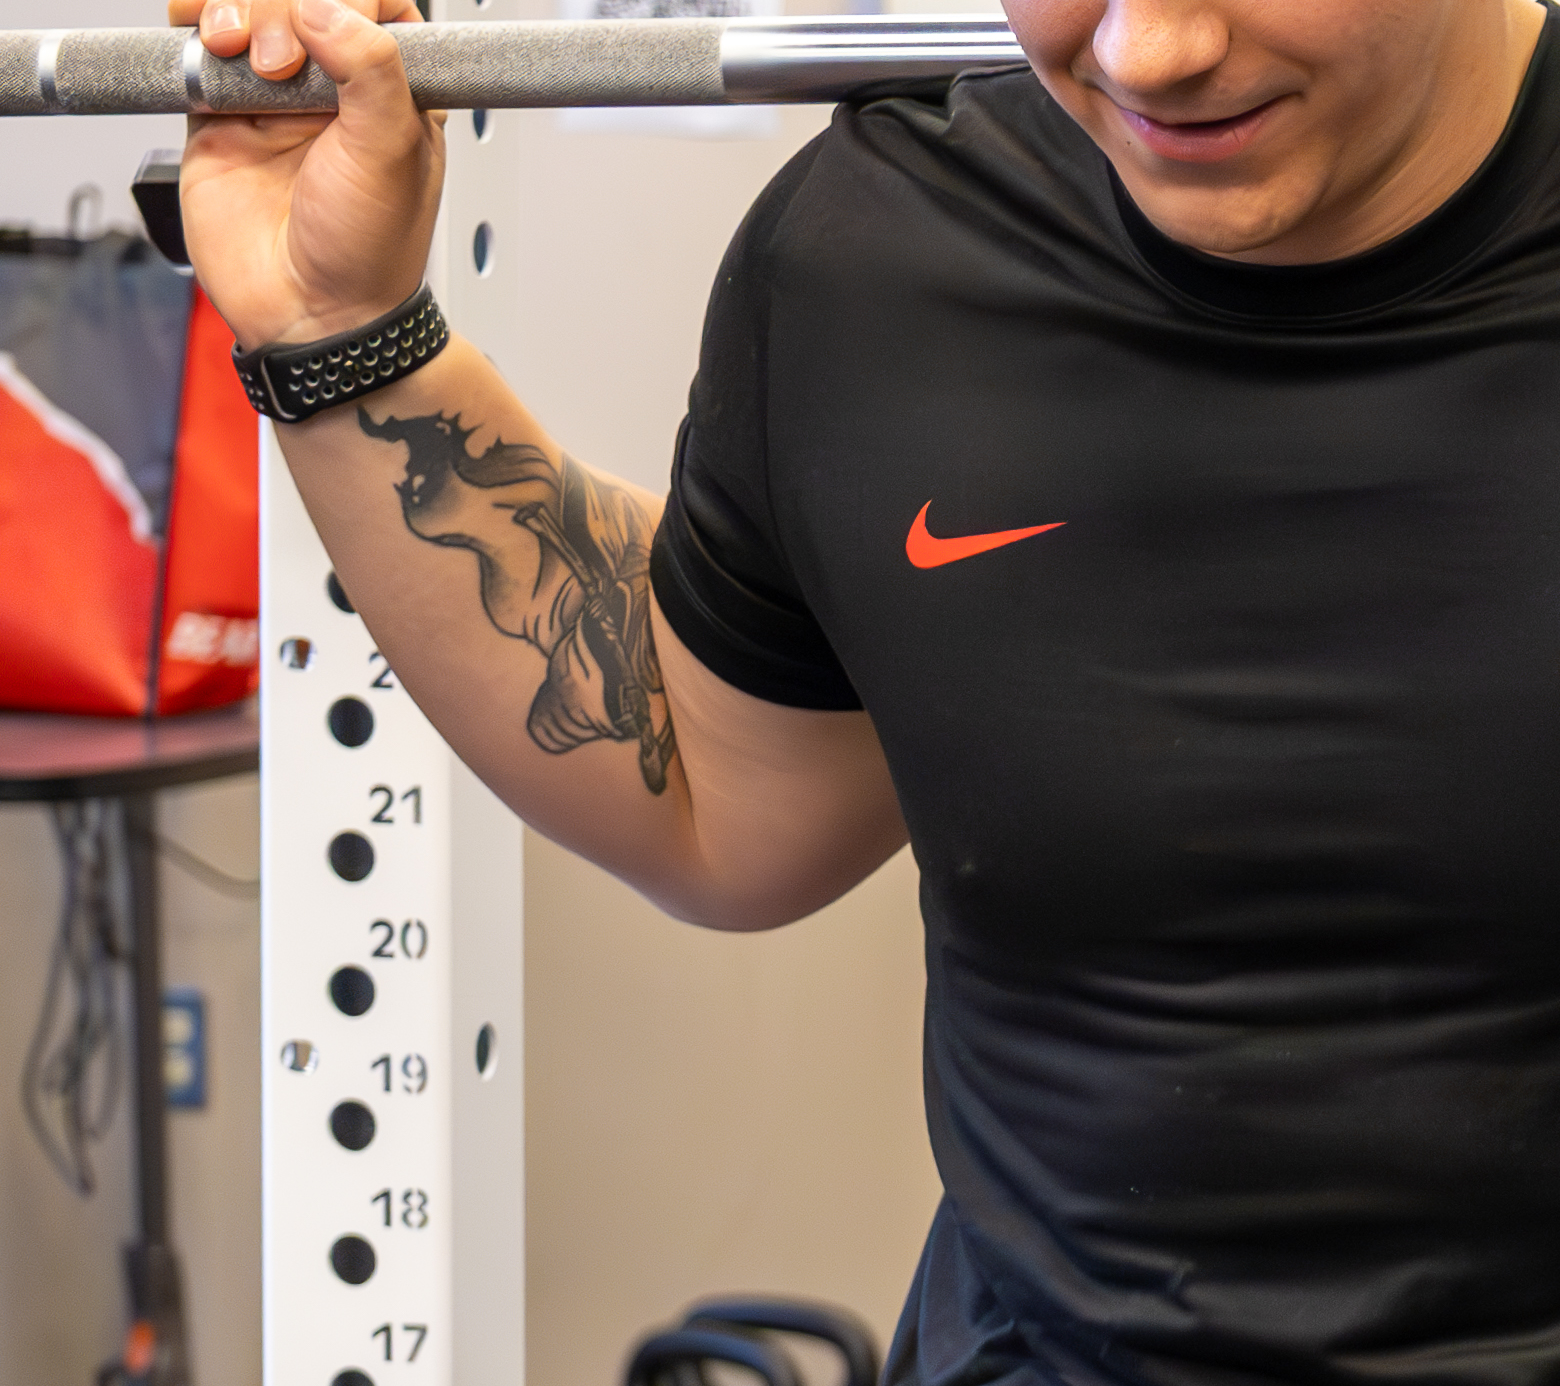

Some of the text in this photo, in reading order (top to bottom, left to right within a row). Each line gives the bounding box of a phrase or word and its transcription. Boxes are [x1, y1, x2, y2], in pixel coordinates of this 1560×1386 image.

[369, 651, 394, 689] 2
[368, 782, 423, 826] 21
[368, 917, 429, 961] 20
[369, 1052, 429, 1095] 19
[370, 1187, 430, 1230] 18
[370, 1321, 429, 1364] 17
